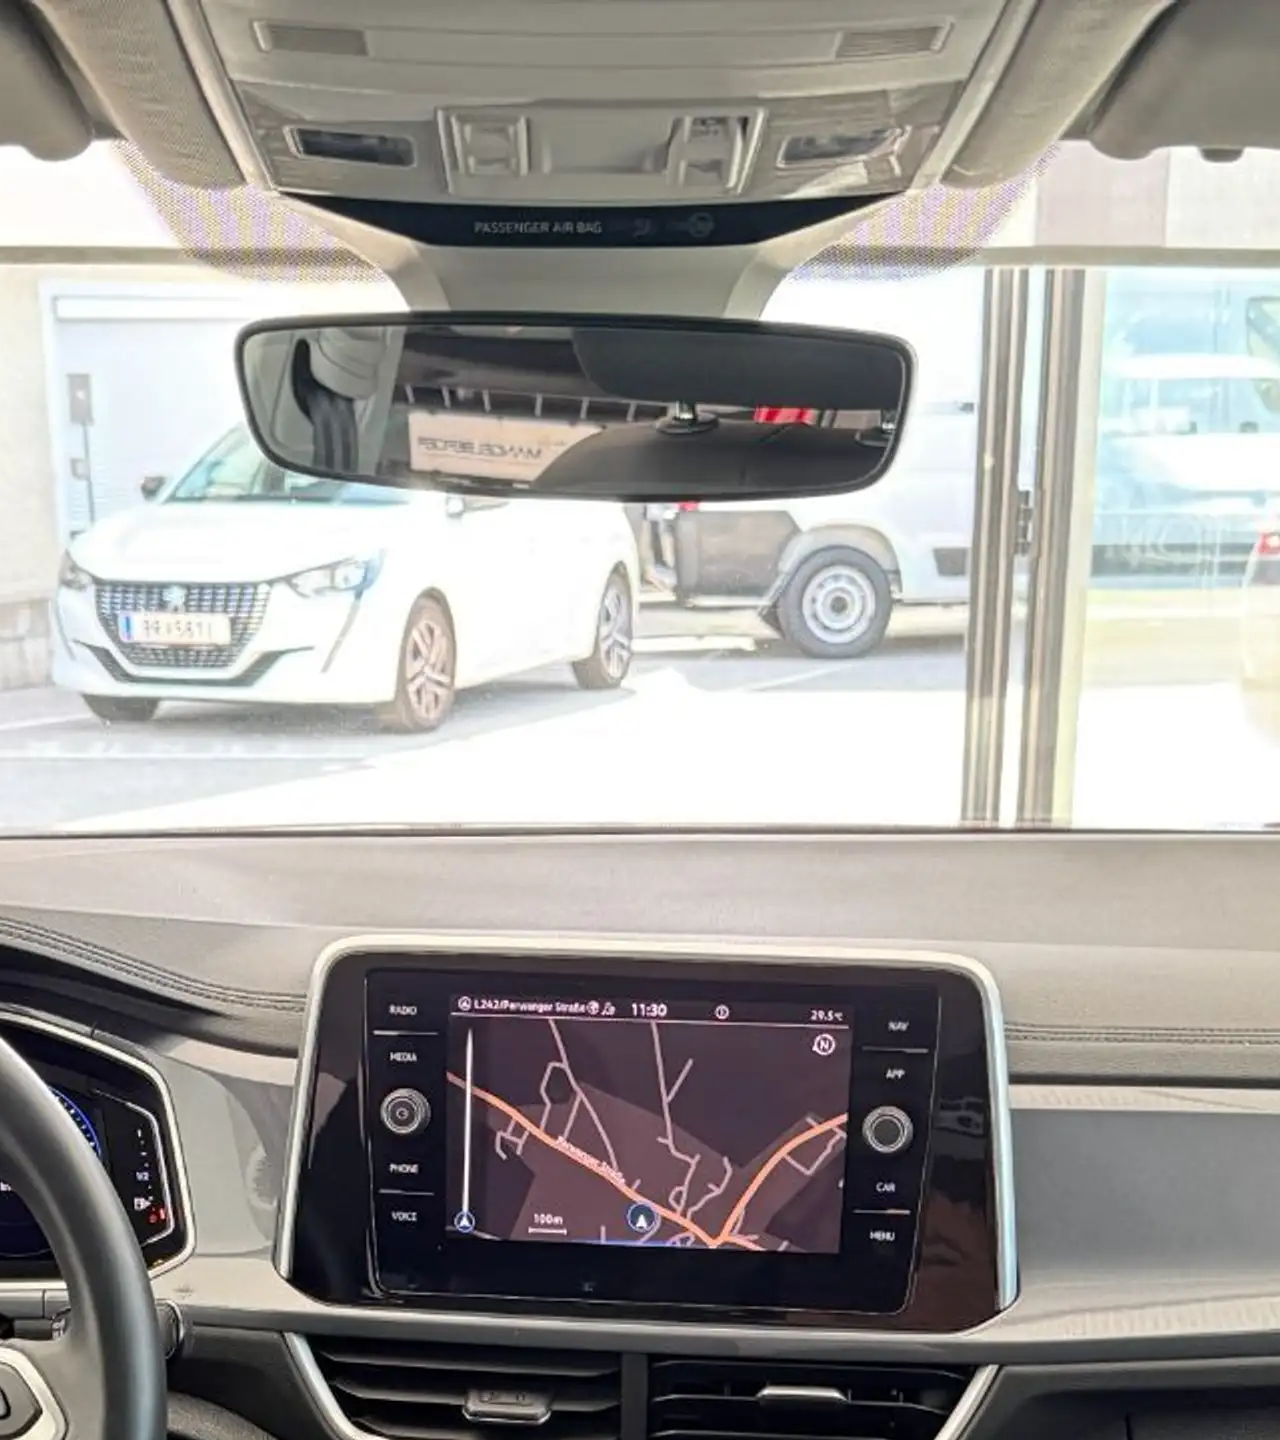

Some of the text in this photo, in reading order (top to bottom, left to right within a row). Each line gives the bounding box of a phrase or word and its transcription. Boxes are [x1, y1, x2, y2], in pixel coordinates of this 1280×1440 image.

[473, 221, 602, 233] PASSENGER AIR BAG
[389, 1004, 418, 1015] RADIO
[631, 1003, 668, 1017] 11:30
[888, 1021, 910, 1031] NAV
[390, 1051, 418, 1062] MEDIA
[885, 1068, 906, 1079] APP
[390, 1163, 419, 1174] PHONE
[876, 1182, 896, 1192] CAR
[391, 1211, 418, 1222] VOICE
[534, 1213, 563, 1225] 100m
[870, 1230, 895, 1242] MENU
